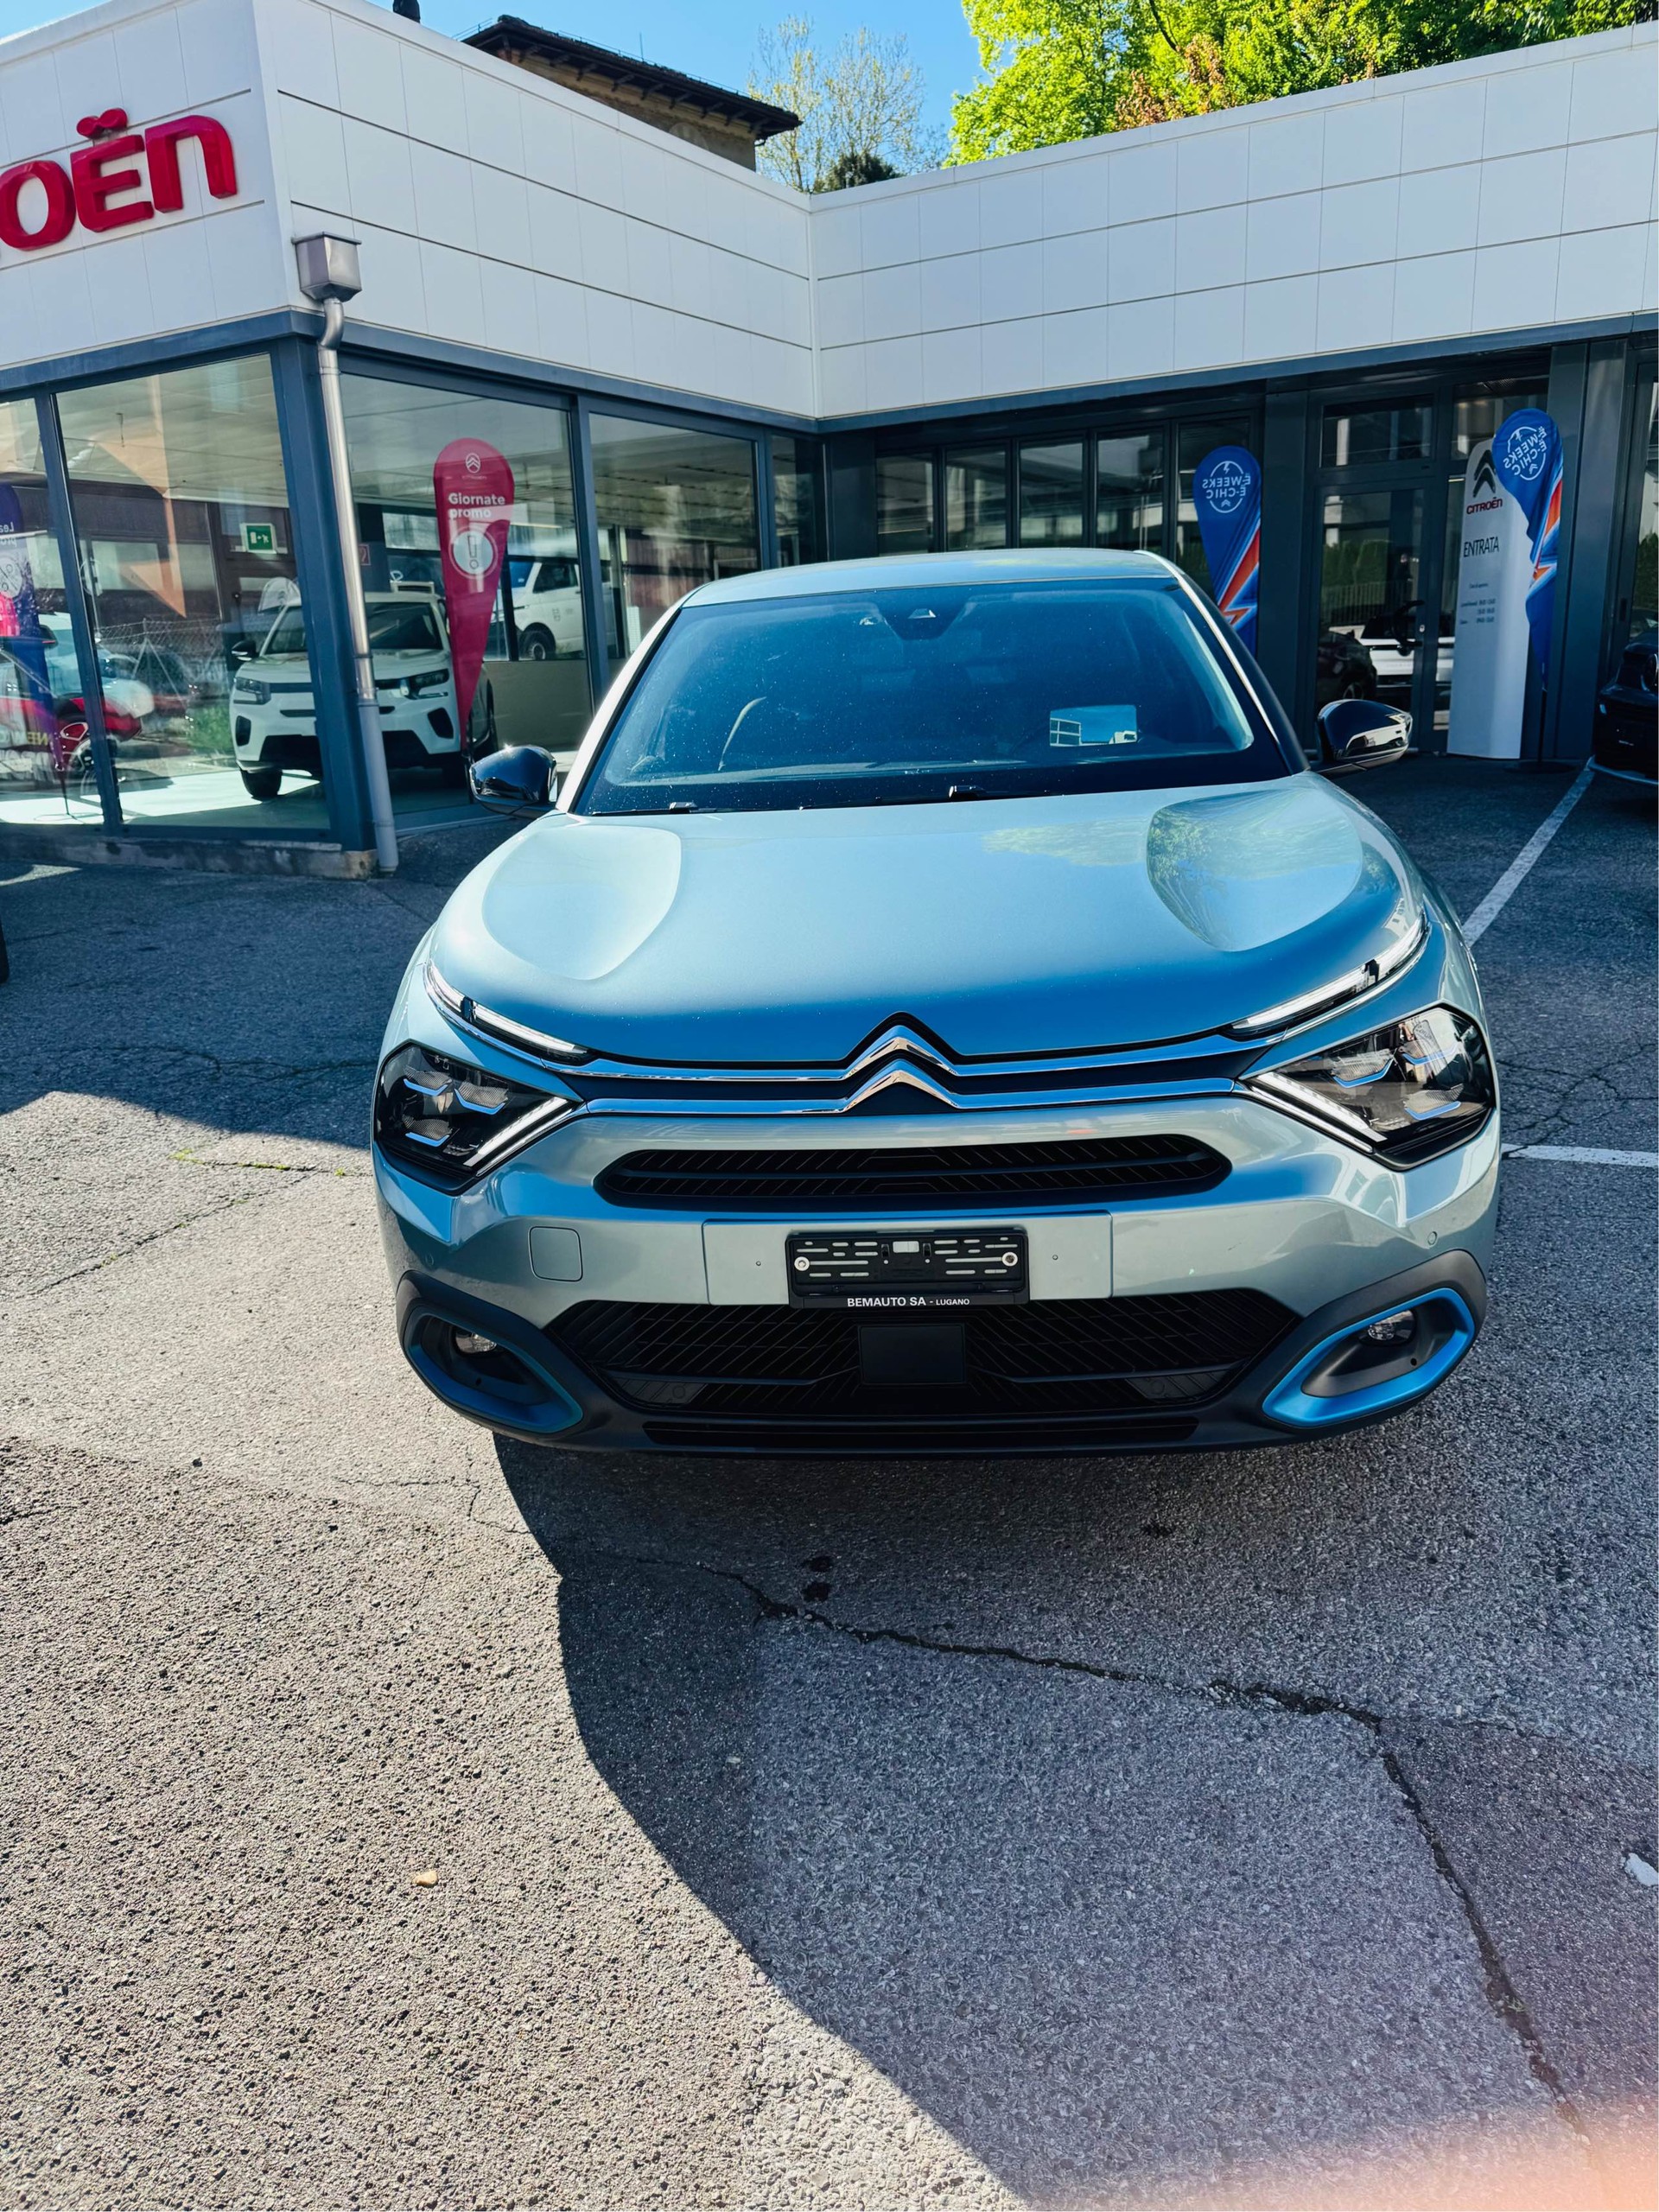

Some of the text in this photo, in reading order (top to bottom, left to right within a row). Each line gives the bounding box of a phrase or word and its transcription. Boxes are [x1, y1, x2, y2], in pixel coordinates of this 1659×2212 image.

[448, 492, 505, 505] Giornate
[448, 508, 492, 520] promo
[1463, 536, 1500, 557] ENTRATA
[847, 1297, 906, 1307] BEMAUTO
[909, 1296, 926, 1306] SA
